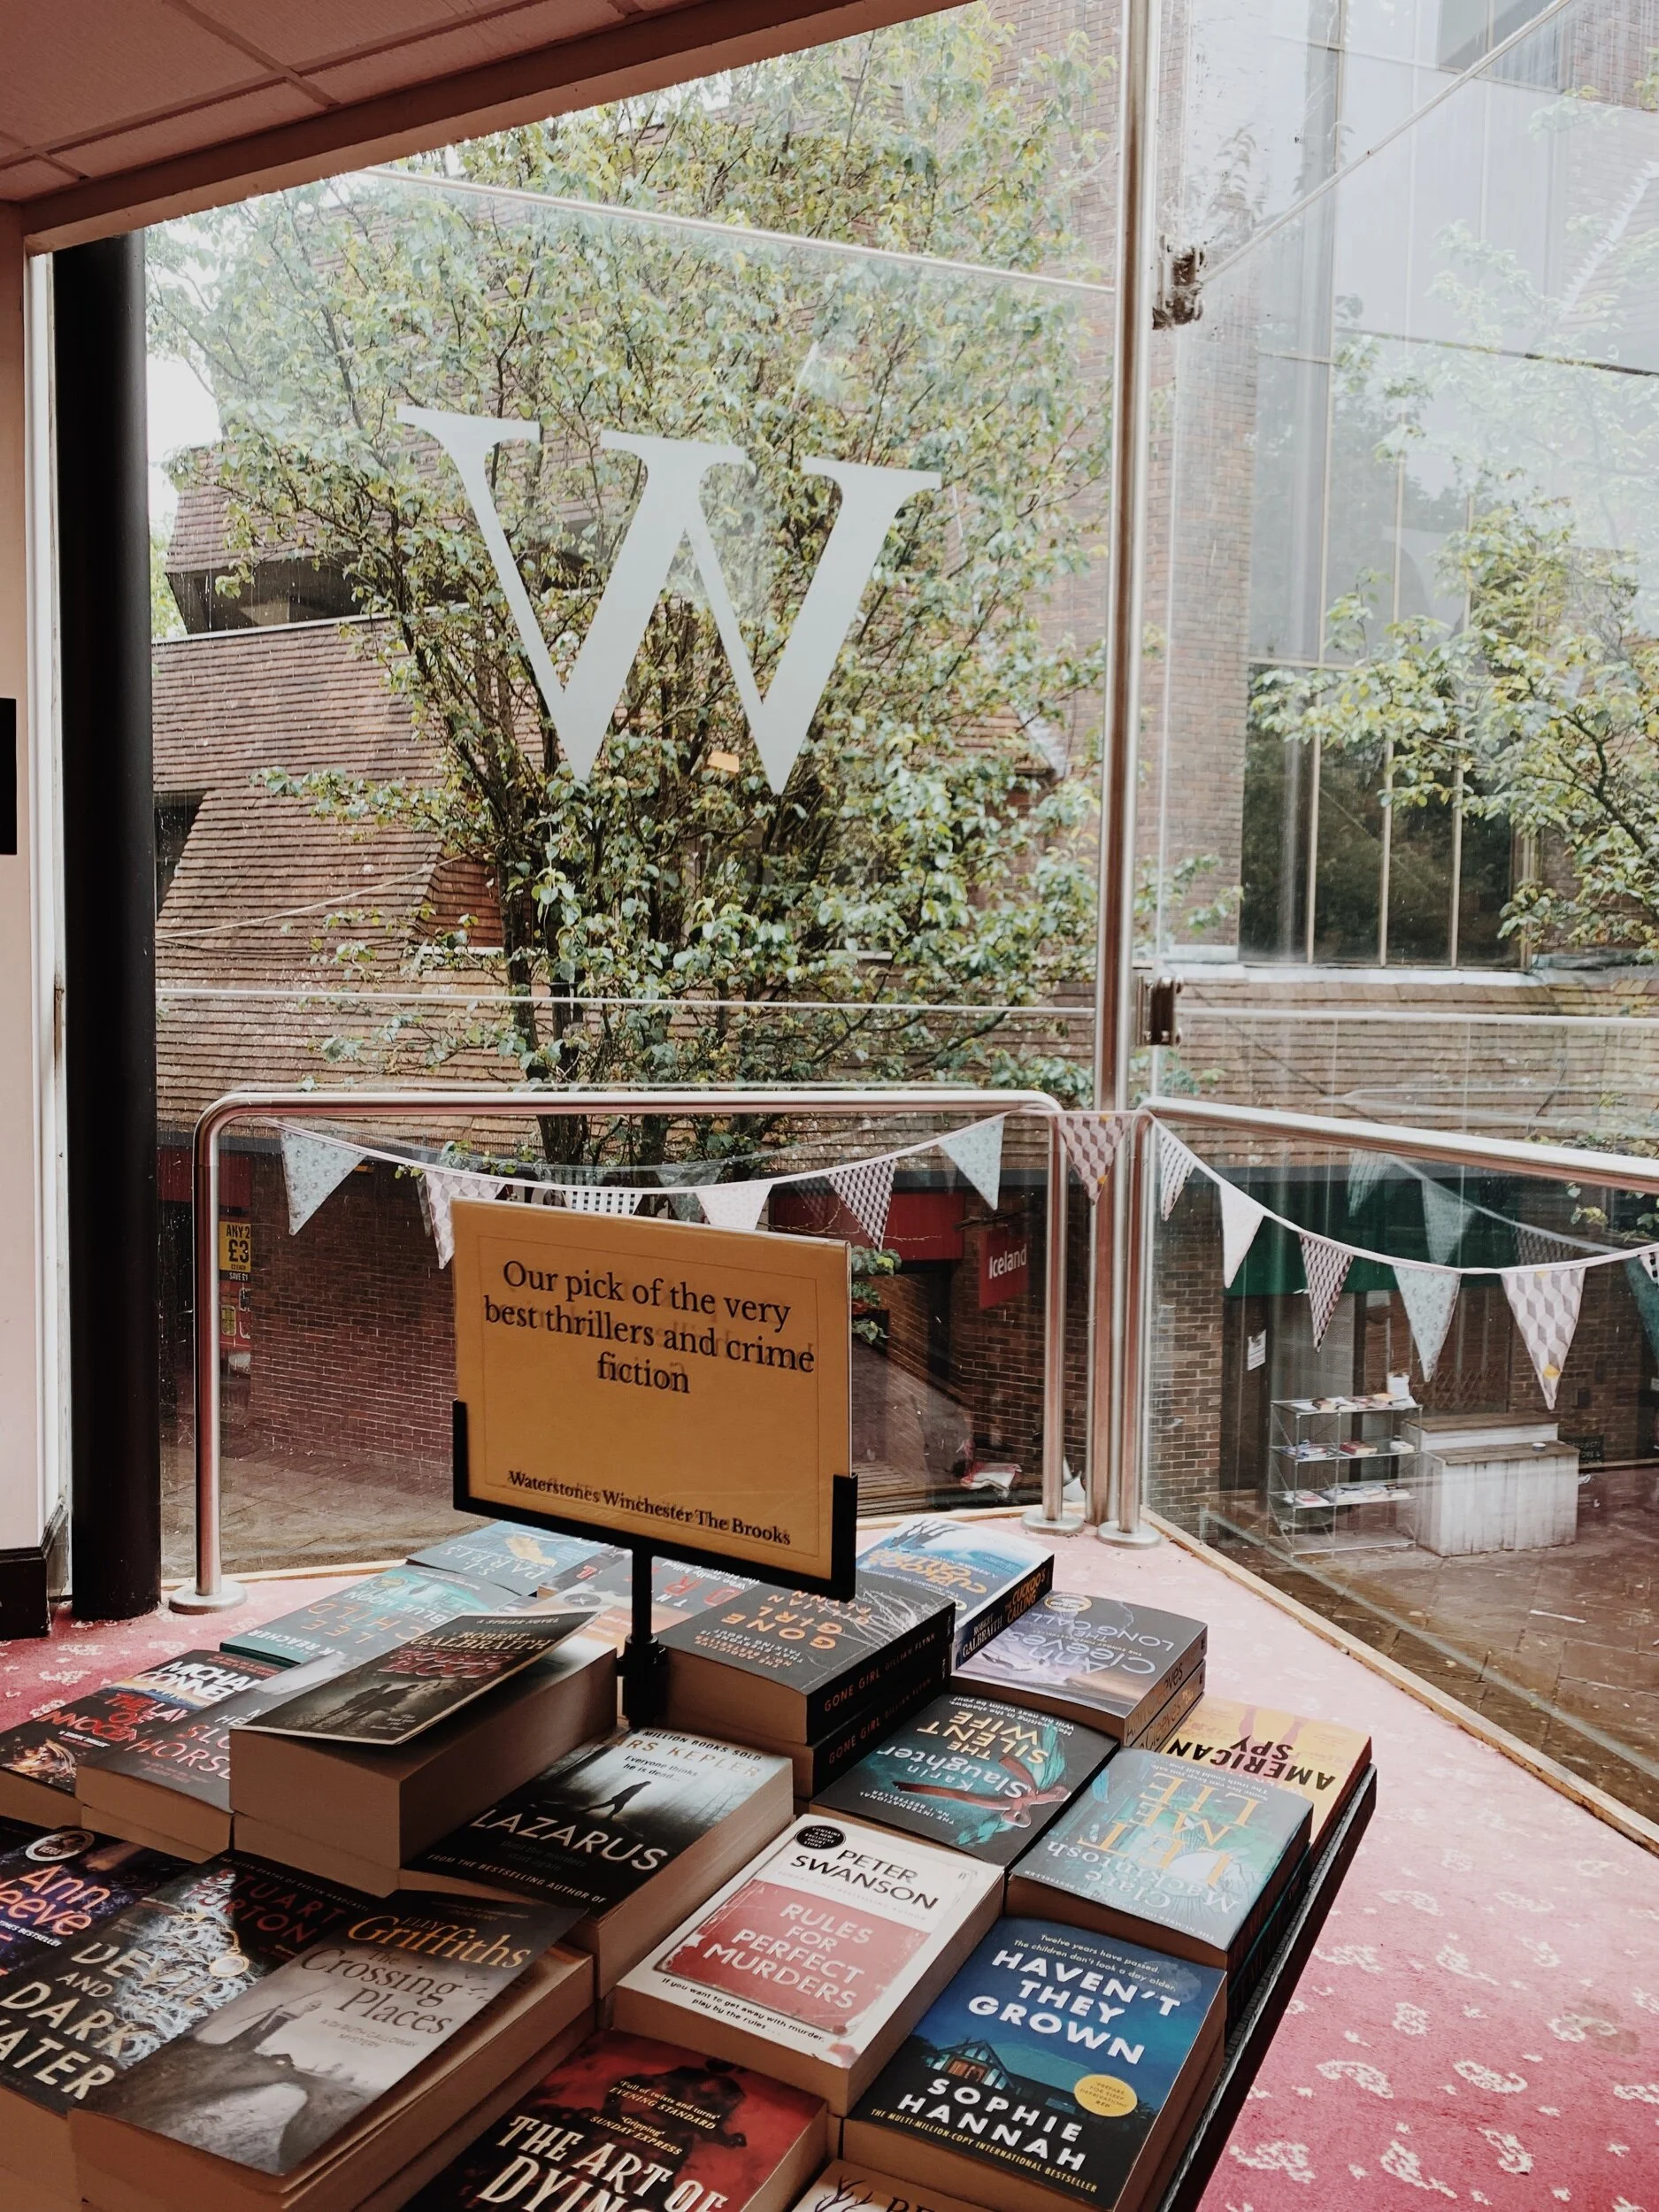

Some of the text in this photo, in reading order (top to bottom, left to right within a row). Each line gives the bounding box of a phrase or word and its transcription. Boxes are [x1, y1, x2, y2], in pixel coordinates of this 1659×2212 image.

[227, 1225, 250, 1239] ANY 2
[228, 1239, 249, 1263] £3
[988, 1243, 1027, 1279] Iceland
[503, 1260, 791, 1333] Our pick of the very
[484, 1295, 815, 1373] best thrillers and crime
[597, 1352, 690, 1394] fiction
[508, 1471, 791, 1547] Waterstones Winchester The Brooks
[441, 1546, 546, 1580] PARRIS
[1012, 1568, 1047, 1604] CUCKOO'S
[308, 1602, 426, 1641] CHILD
[343, 1591, 448, 1624] BLUE MOON
[757, 1604, 843, 1636] GIRL
[766, 1594, 871, 1625] GILLIAN
[973, 1612, 995, 1636] ROBERT
[1007, 1590, 1036, 1623] CALLING
[248, 1629, 321, 1651] REACHER
[300, 1620, 376, 1645] LEE
[410, 1637, 556, 1651] GALBRAITH
[458, 1632, 530, 1641] ROBERT
[720, 1611, 837, 1651] GONE
[963, 1616, 1003, 1657] GALBRAITH
[1032, 1612, 1175, 1652] LONG CALL
[1071, 1630, 1107, 1643] THE
[377, 1660, 503, 1679] BLOOD
[824, 1632, 936, 1712] GONE GIRL GILLIAN FLYNN
[1001, 1631, 1157, 1674] Cleeves
[1027, 1645, 1110, 1674] Ann
[949, 1710, 1038, 1746] WIFE
[989, 1702, 1017, 1714] victim
[1017, 1715, 1050, 1729] waiting
[1018, 1710, 1040, 1719] next
[1055, 1721, 1075, 1732] Will
[642, 1731, 763, 1762] MILLION BOOKS SOLD
[828, 1717, 881, 1764] GONE GIRL
[917, 1721, 1049, 1764] SILENT
[947, 1740, 992, 1761] THE
[1230, 1735, 1294, 1761] SPY
[624, 1755, 699, 1778] Everyone thinks
[665, 1746, 761, 1778] KEPLER
[874, 1745, 1030, 1799] Slaughter
[907, 1765, 973, 1793] Karin
[1167, 1737, 1337, 1792] AMERICAN
[1202, 1771, 1226, 1781] could
[872, 1790, 926, 1809] BESTSELLER
[1147, 1771, 1265, 1830] LIE
[1226, 1778, 1249, 1789] truth
[859, 1791, 934, 1817] INTERNATIONAL
[1128, 1800, 1236, 1846] ME
[469, 1807, 670, 1872] LAZARUS
[1077, 1820, 1236, 1886] LET
[426, 1854, 610, 1904] FROM THE BESTSELLING AUTHOR OF
[790, 1855, 939, 1910] SWANSON
[837, 1849, 918, 1884] PETER
[1046, 1839, 1240, 1916] Mackintosh
[18, 1864, 111, 1911] Ann
[219, 1868, 348, 1924] STUART
[1084, 1869, 1171, 1909] Clare
[348, 1916, 532, 1969] Griffiths
[779, 1902, 876, 1945] RULES
[784, 1924, 840, 1954] FOR
[367, 1949, 397, 1966] The
[731, 1928, 867, 1985] PERFECT
[1013, 1939, 1030, 1949] The
[1031, 1943, 1068, 1959] children
[1069, 1953, 1094, 1966] don't
[1095, 1959, 1118, 1973] look
[1127, 1970, 1148, 1984] day
[1148, 1977, 1178, 1993] older.
[1040, 1934, 1161, 1975] Twelve years have passed.
[56, 1971, 115, 1998] AND
[302, 1948, 464, 2008] Crossing
[703, 1943, 859, 2009] MURDERS
[991, 1948, 1182, 2017] HAVEN'T
[0, 1981, 135, 2059] DARK
[334, 1987, 453, 2034] Places
[671, 1981, 688, 1991] you
[689, 1986, 711, 2000] want
[724, 2000, 741, 2010] get
[741, 2006, 765, 2020] away
[766, 2016, 787, 2028] with
[788, 2024, 826, 2043] murder.
[692, 1998, 741, 2019] play by the
[1018, 1978, 1126, 2024] THEY
[967, 1994, 1147, 2066] GROWN
[0, 2018, 116, 2101] ATER
[609, 2086, 718, 2131] EVENING STANDARD
[639, 2085, 695, 2111] of twists and
[926, 2077, 1084, 2144] SOPHIE
[589, 2116, 684, 2156] SUNDAY EXPRESS
[870, 2108, 1099, 2193] THE MULTI-MILLION-COPY INTERNATIONAL BESTSELLER
[896, 2093, 1088, 2173] HANNAH
[496, 2115, 730, 2212] THE ART OF
